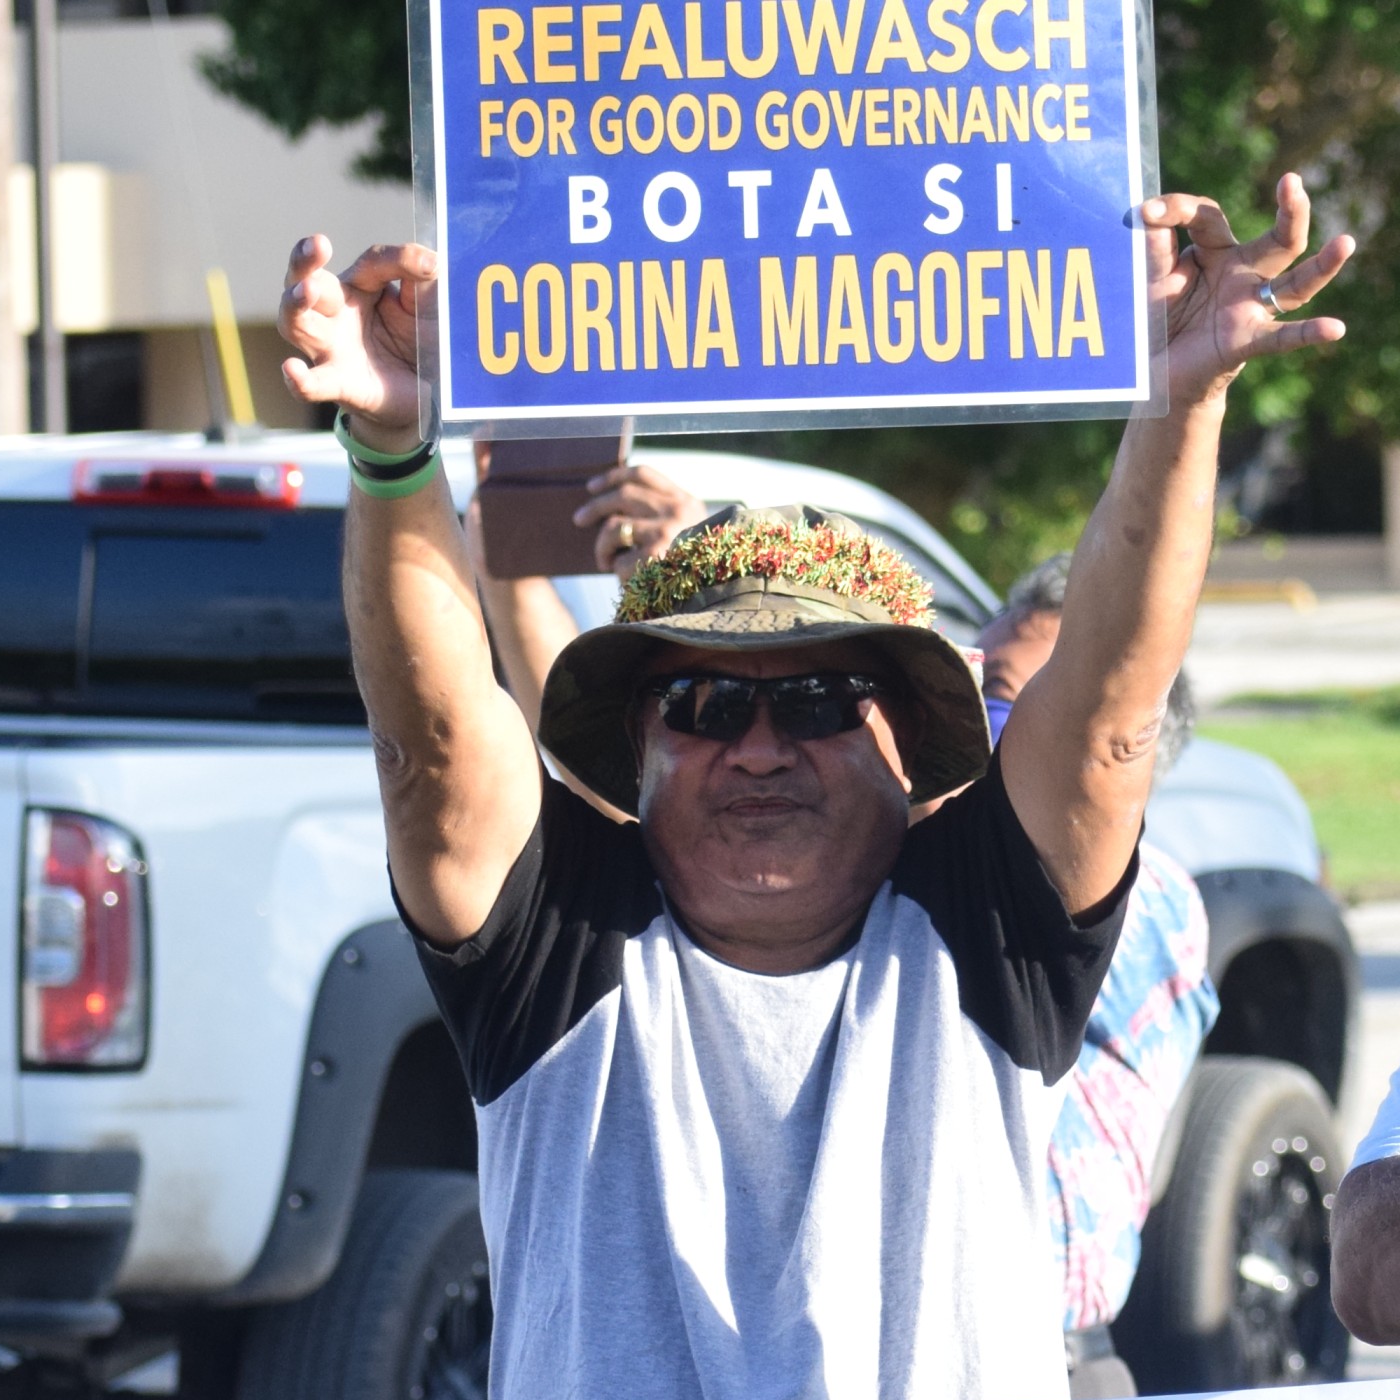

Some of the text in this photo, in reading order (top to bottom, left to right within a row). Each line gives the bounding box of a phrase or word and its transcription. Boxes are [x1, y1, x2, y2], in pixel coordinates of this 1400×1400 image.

[477, 0, 1087, 84] REFALUWASCH
[480, 83, 1091, 157] FOR GOOD GOVERNANCE
[568, 163, 1014, 244] BOTA SI
[476, 247, 1105, 375] CORINA MAGOFNA
